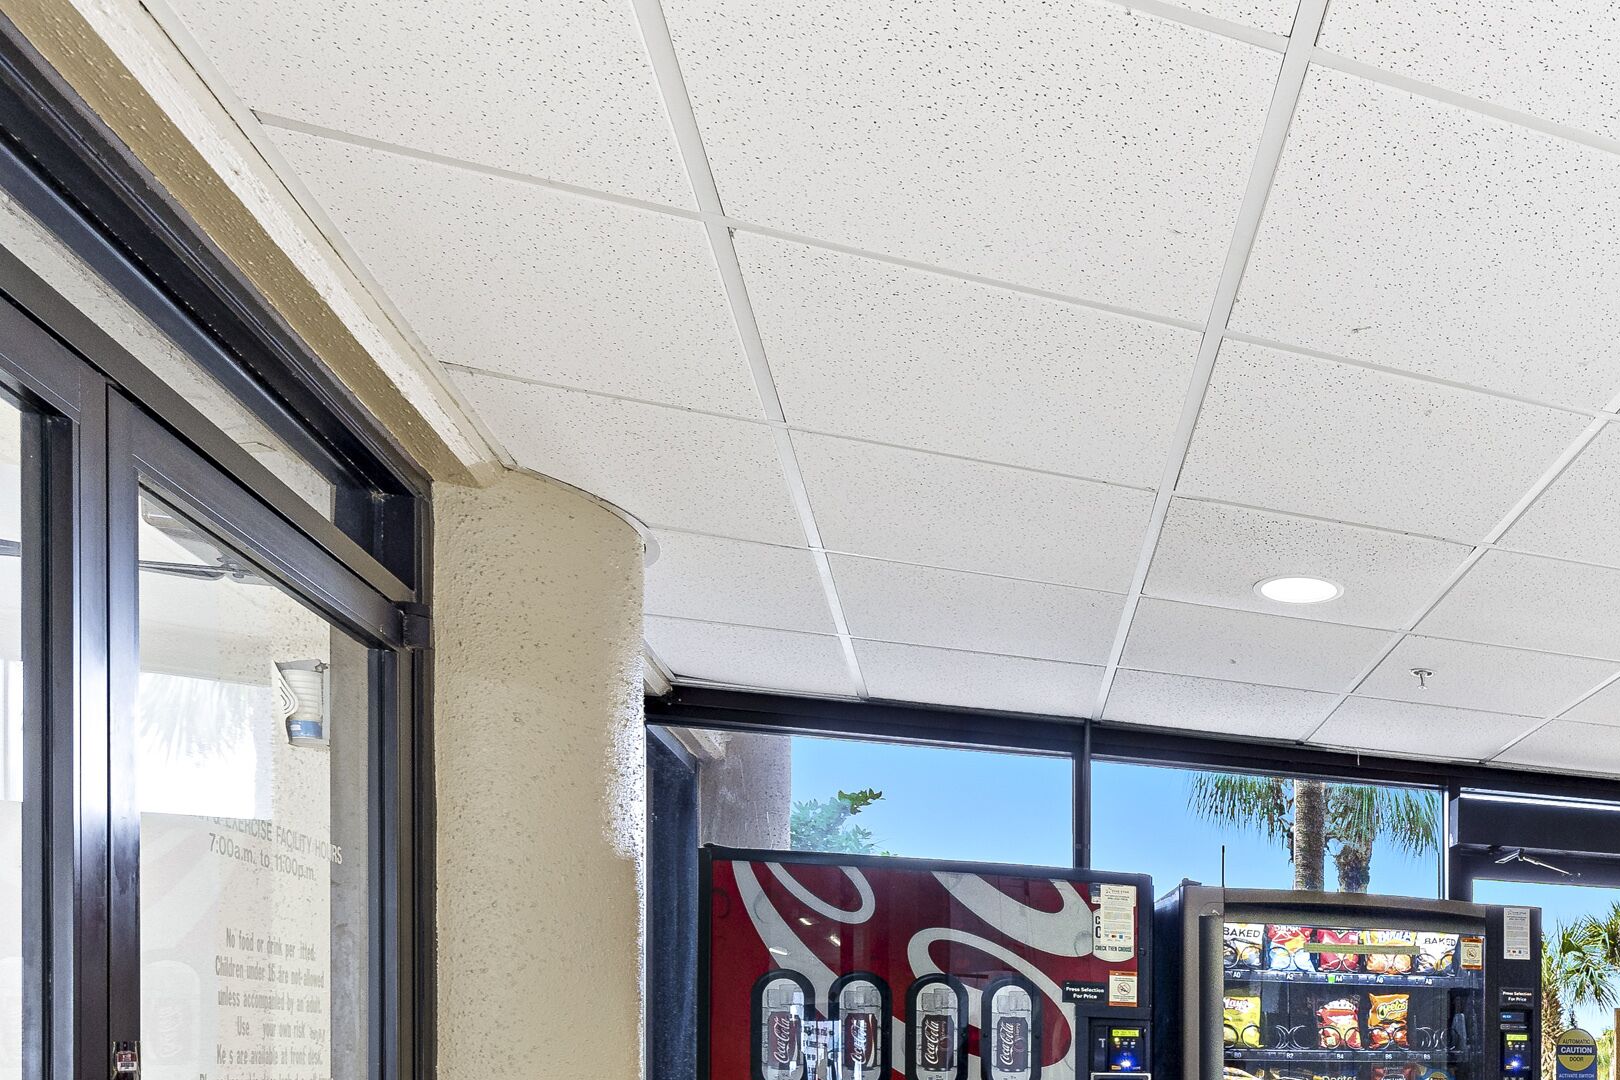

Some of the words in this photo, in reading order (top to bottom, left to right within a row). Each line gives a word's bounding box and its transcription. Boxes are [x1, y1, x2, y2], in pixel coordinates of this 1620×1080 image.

[260, 850, 270, 867] to
[226, 927, 236, 949] No
[239, 929, 254, 952] food
[256, 938, 264, 953] or
[267, 935, 283, 956] drink
[1223, 926, 1261, 939] BAKED
[1424, 936, 1458, 948] BAKED
[215, 955, 244, 979] Children
[246, 961, 265, 981] under
[218, 986, 240, 1008] unless
[236, 1016, 250, 1037] Use
[924, 1019, 940, 1065] Coca-Cola
[1000, 1021, 1015, 1066] Coca-Cola
[1560, 1046, 1592, 1054] CAUTION
